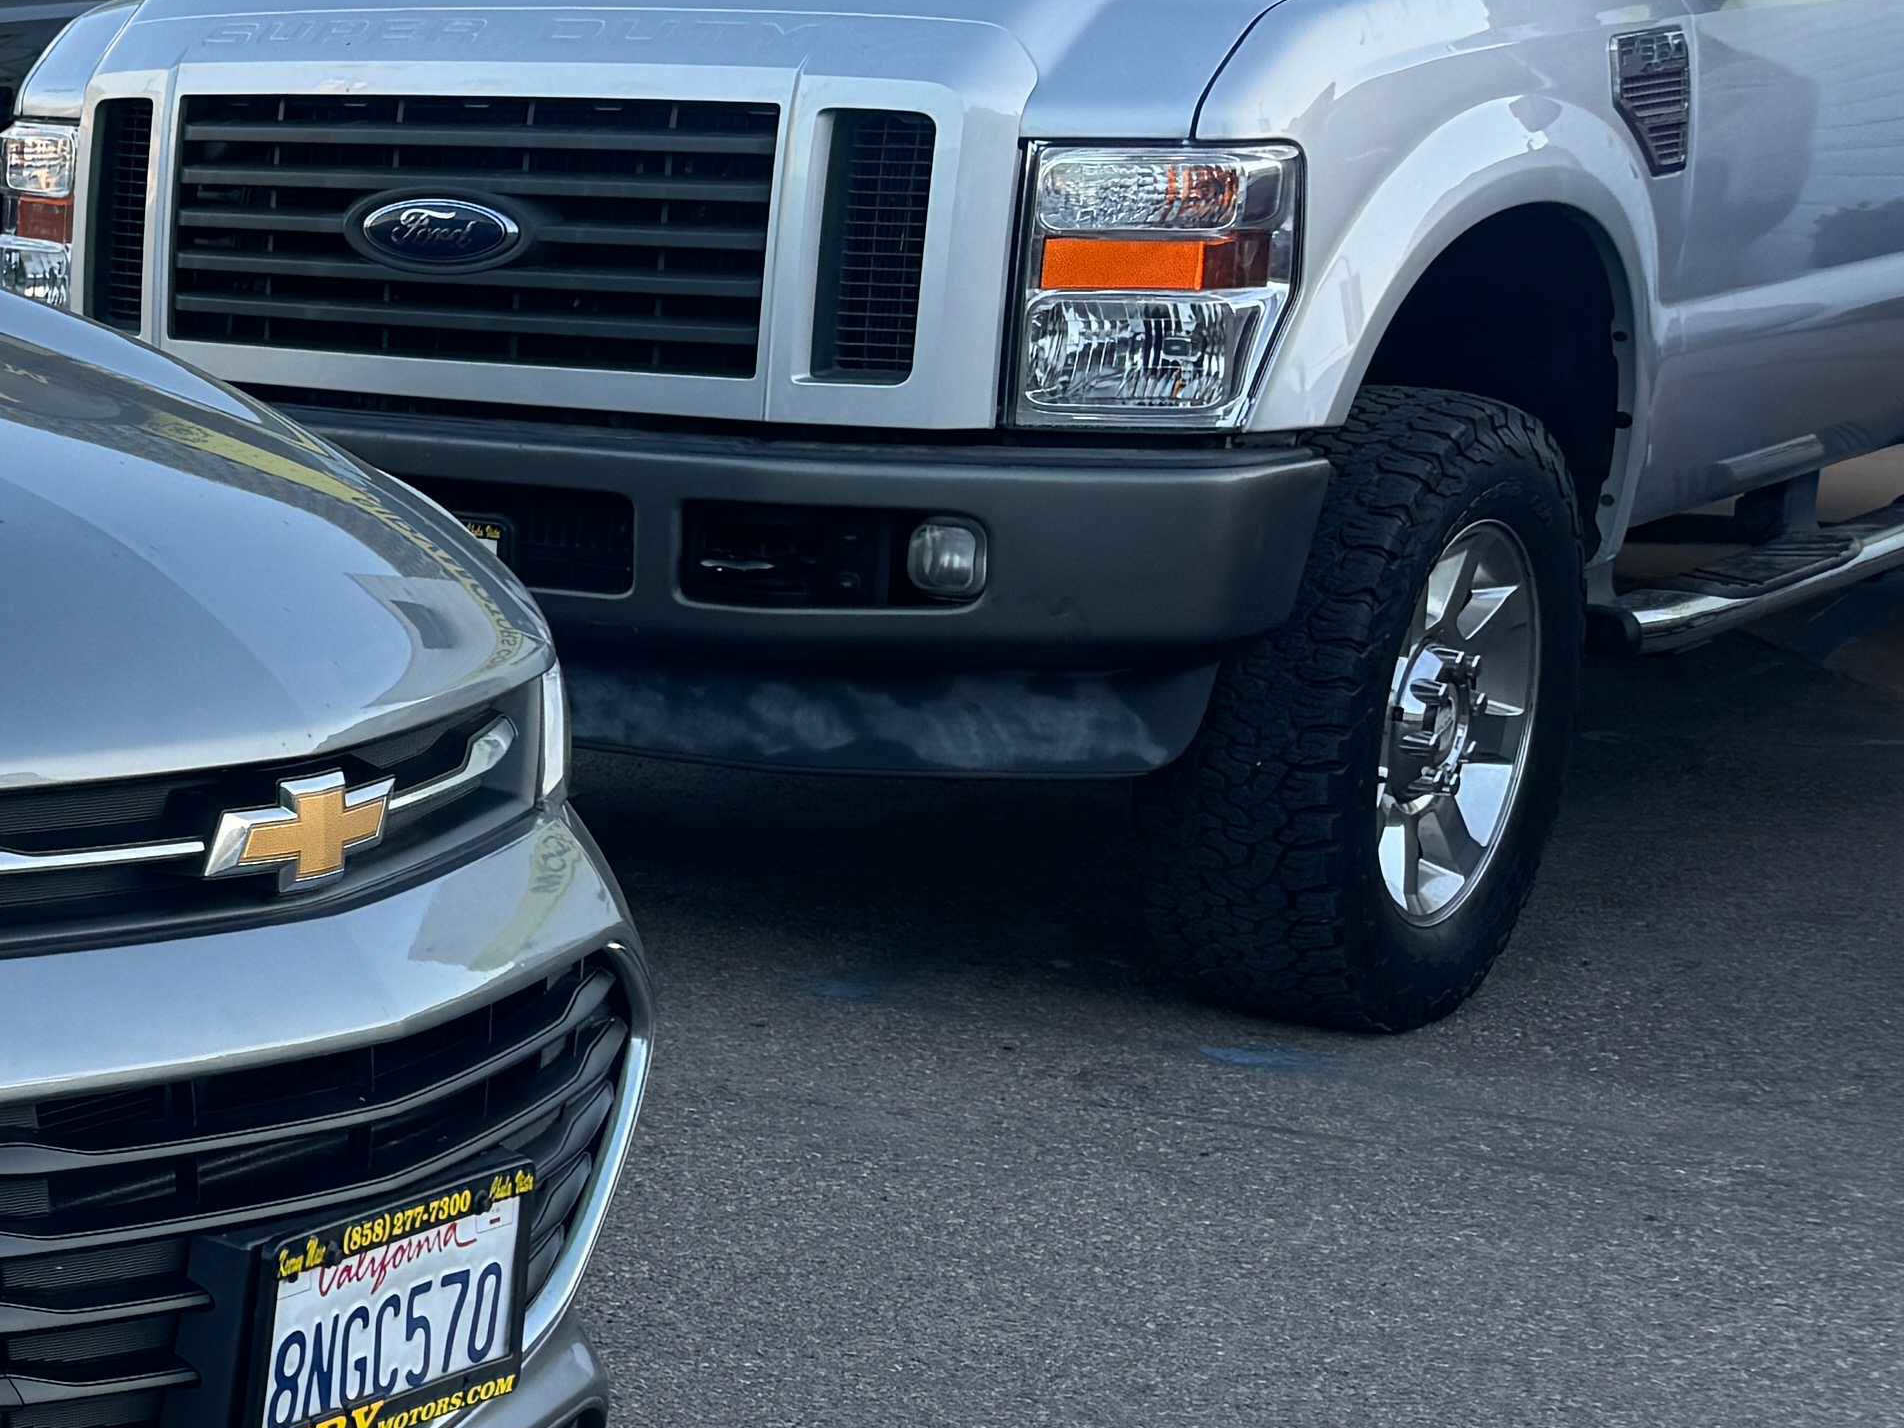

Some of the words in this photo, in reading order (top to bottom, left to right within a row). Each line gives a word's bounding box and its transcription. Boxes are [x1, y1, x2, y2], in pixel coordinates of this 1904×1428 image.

[390, 208, 478, 249] Ford
[342, 1214, 391, 1255] (858)
[392, 1189, 472, 1234] 277-7300
[318, 1222, 477, 1298] California
